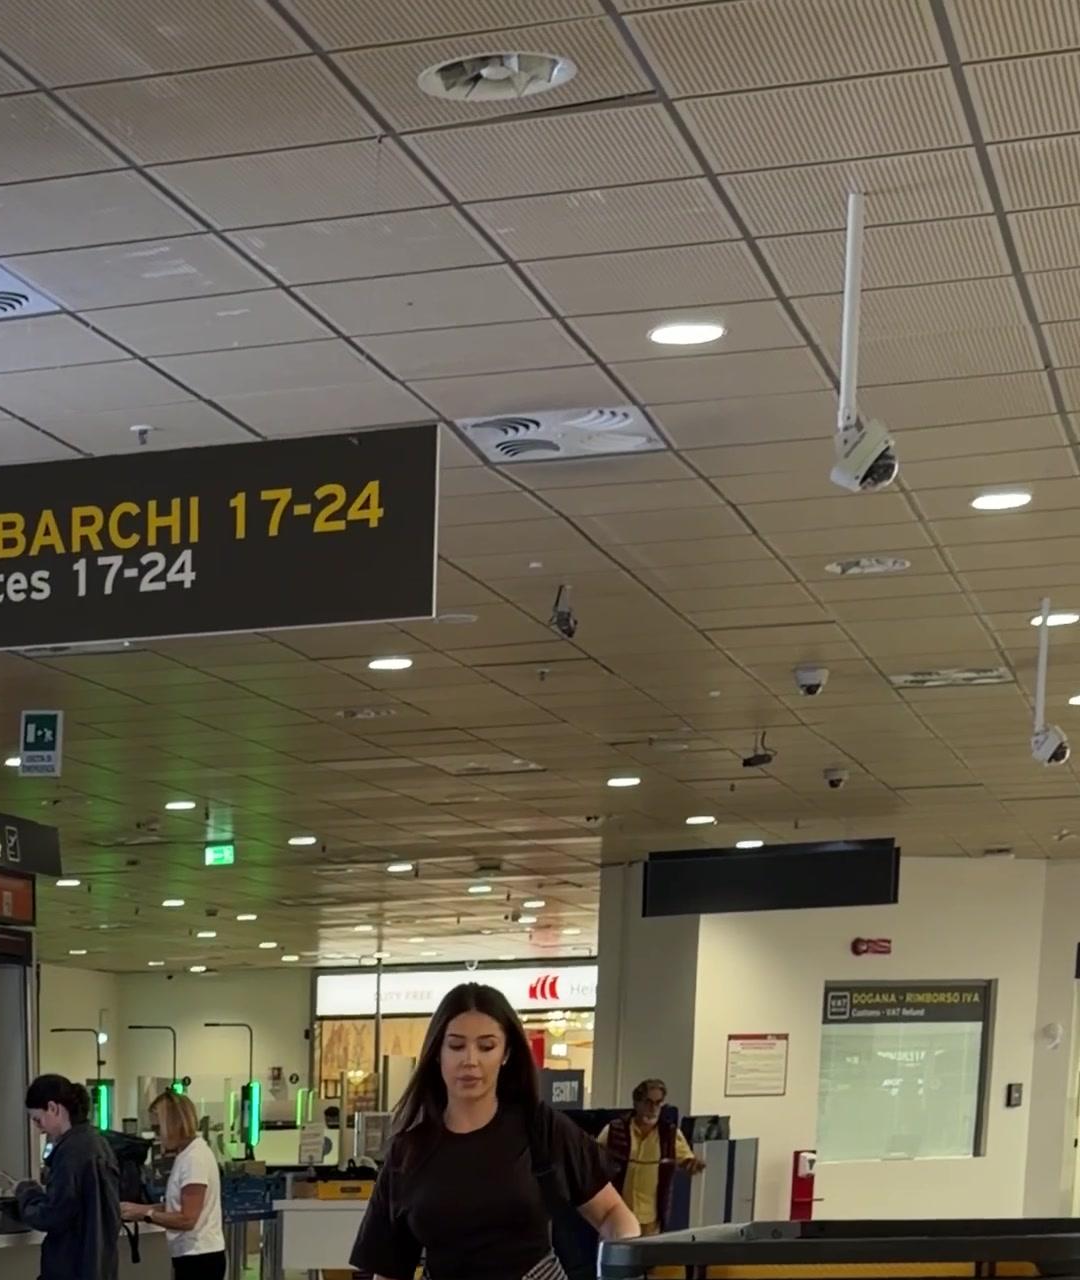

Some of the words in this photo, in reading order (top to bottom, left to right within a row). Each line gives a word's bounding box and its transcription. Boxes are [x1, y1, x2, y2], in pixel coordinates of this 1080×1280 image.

[229, 480, 385, 540] 17-24
[72, 549, 197, 597] 17-24
[852, 992, 897, 1005] DOGANA
[905, 991, 961, 1004] RIMBORSO
[962, 991, 980, 1004] IVA
